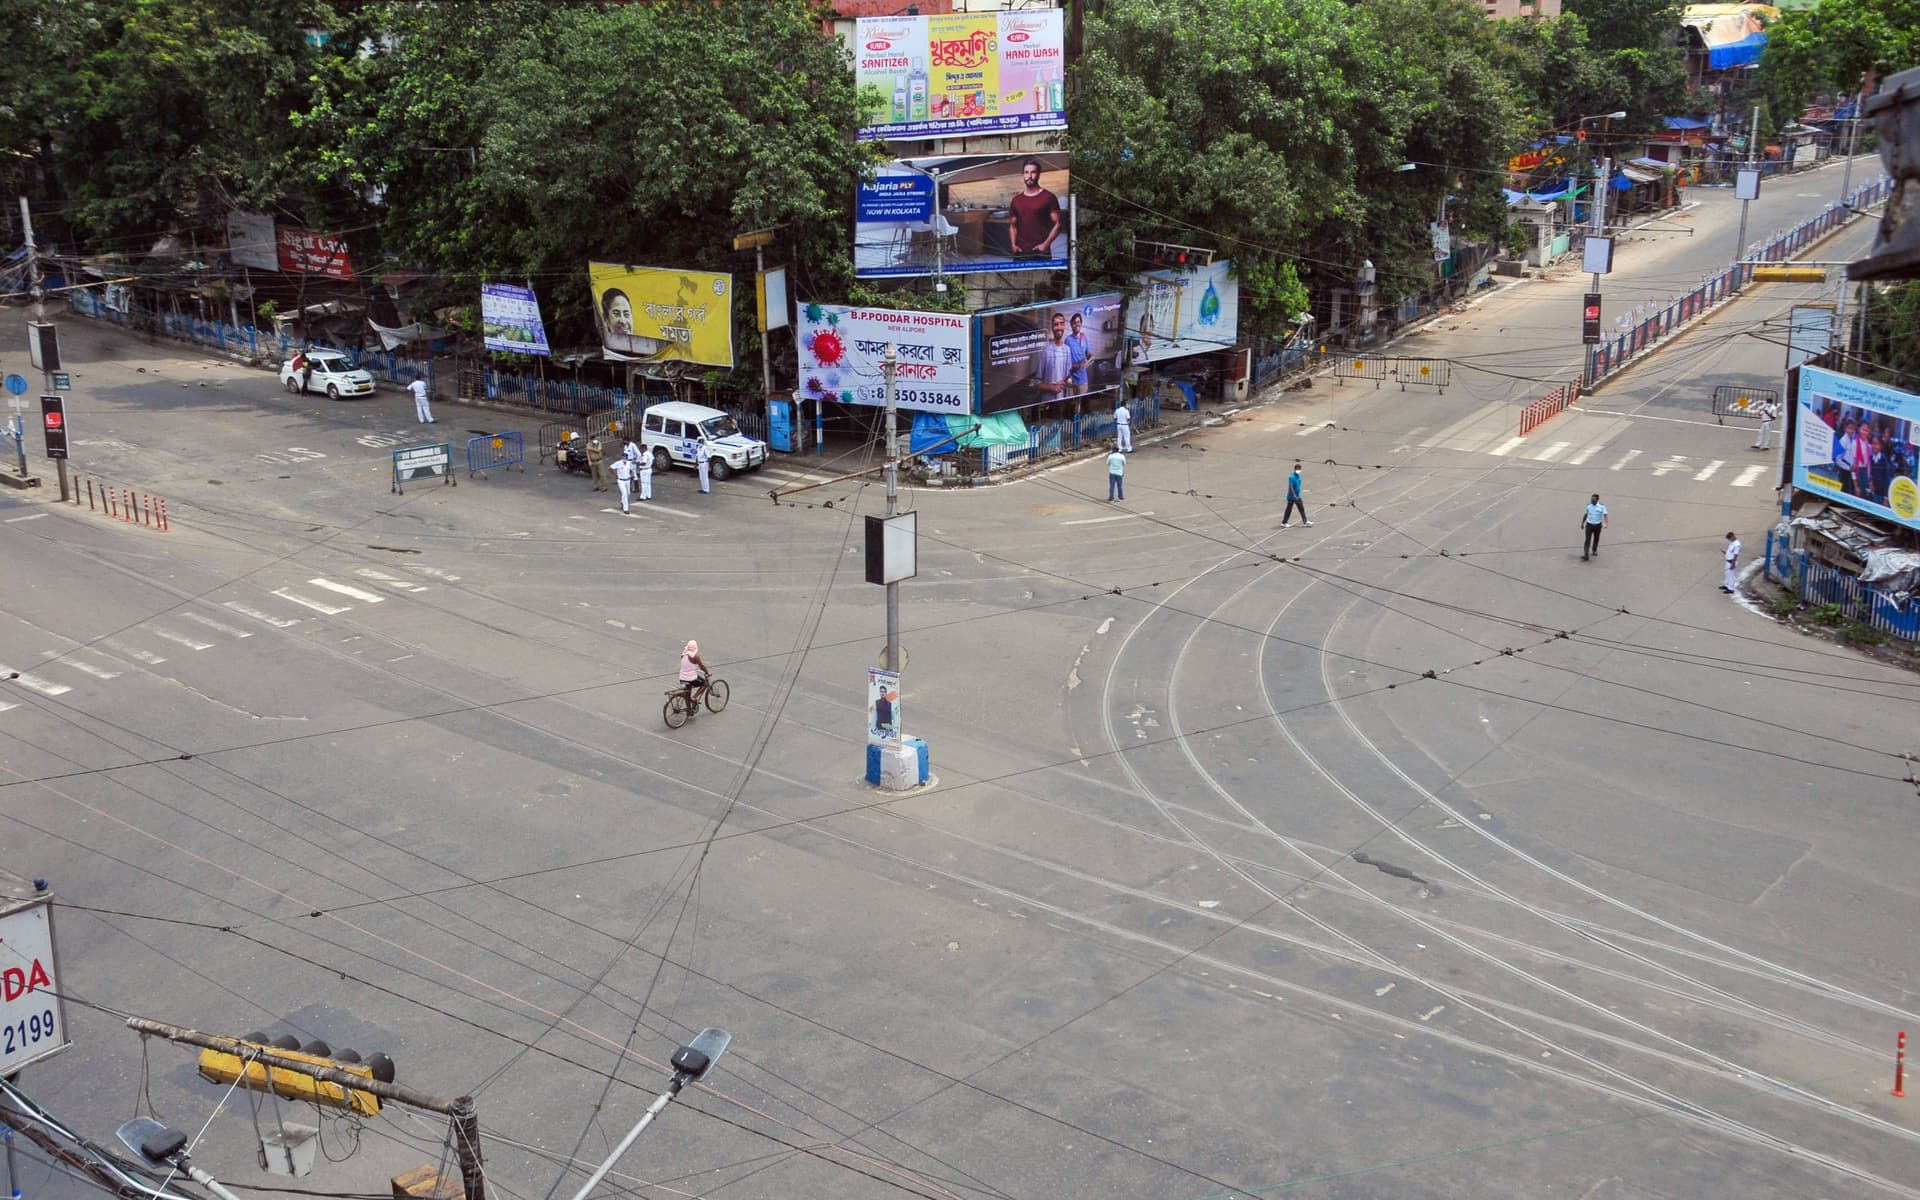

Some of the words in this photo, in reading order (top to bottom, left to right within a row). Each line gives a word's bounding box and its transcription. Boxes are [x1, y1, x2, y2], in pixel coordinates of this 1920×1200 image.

[1006, 49, 1030, 60] HAND
[1033, 47, 1059, 58] WASH
[861, 57, 909, 68] SANITIZER
[851, 311, 911, 324] B.P.PODDAR
[913, 316, 964, 328] HOSPITAL
[896, 343, 934, 361] করবো
[920, 391, 961, 406] 35846
[0, 958, 51, 1003] DA
[3, 1009, 55, 1055] 2199
